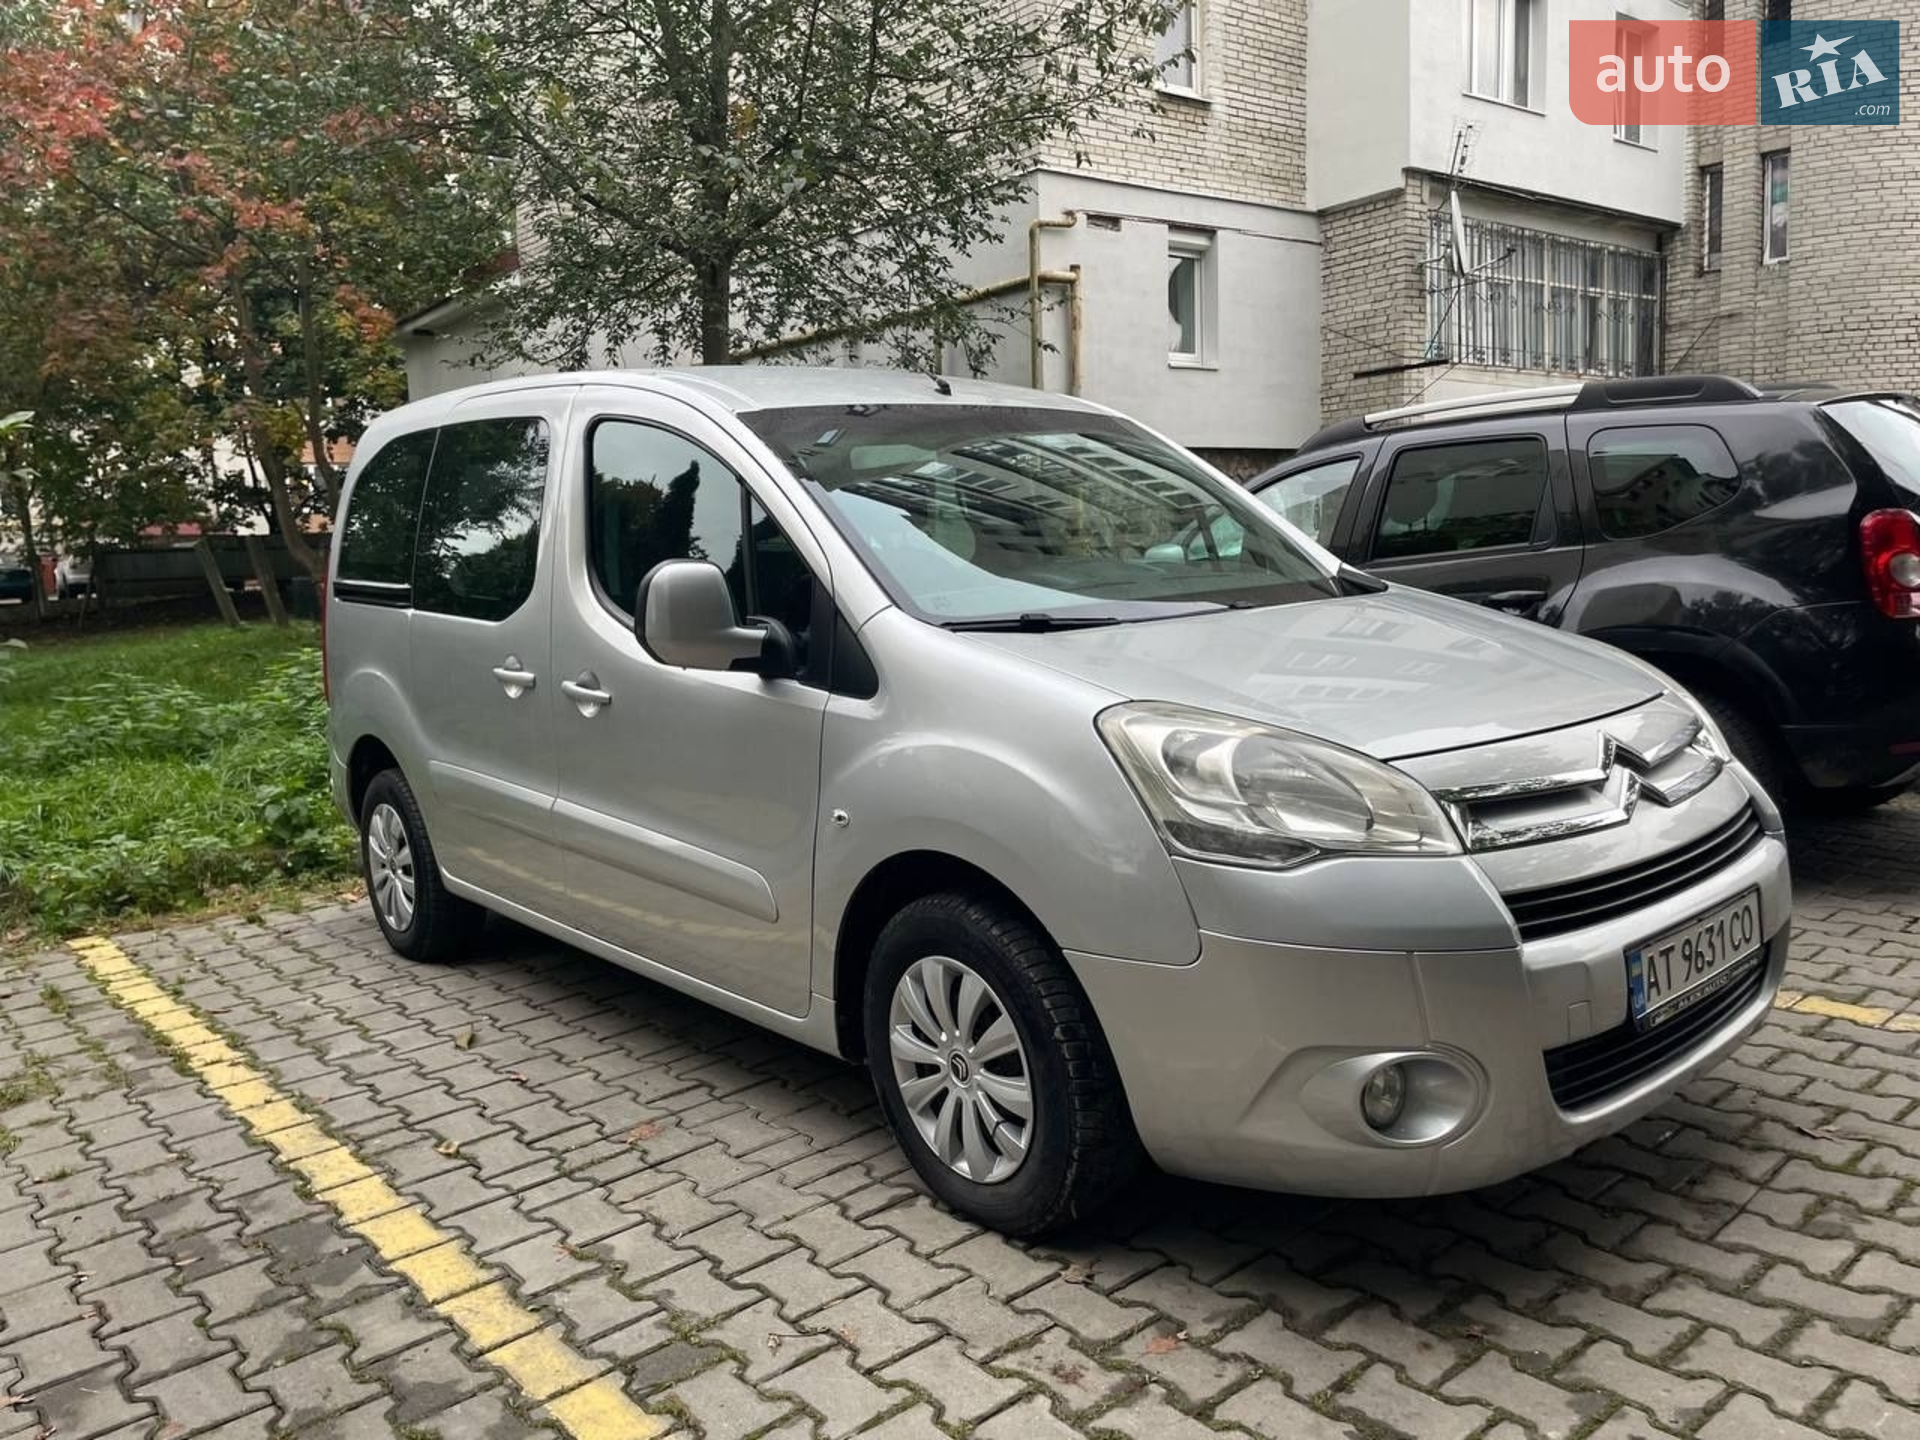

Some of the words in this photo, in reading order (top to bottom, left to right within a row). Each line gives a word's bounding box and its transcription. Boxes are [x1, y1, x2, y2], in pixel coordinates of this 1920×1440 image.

[1646, 943, 1676, 1003] AT
[1681, 918, 1726, 982] 9631
[1729, 905, 1754, 951] CO
